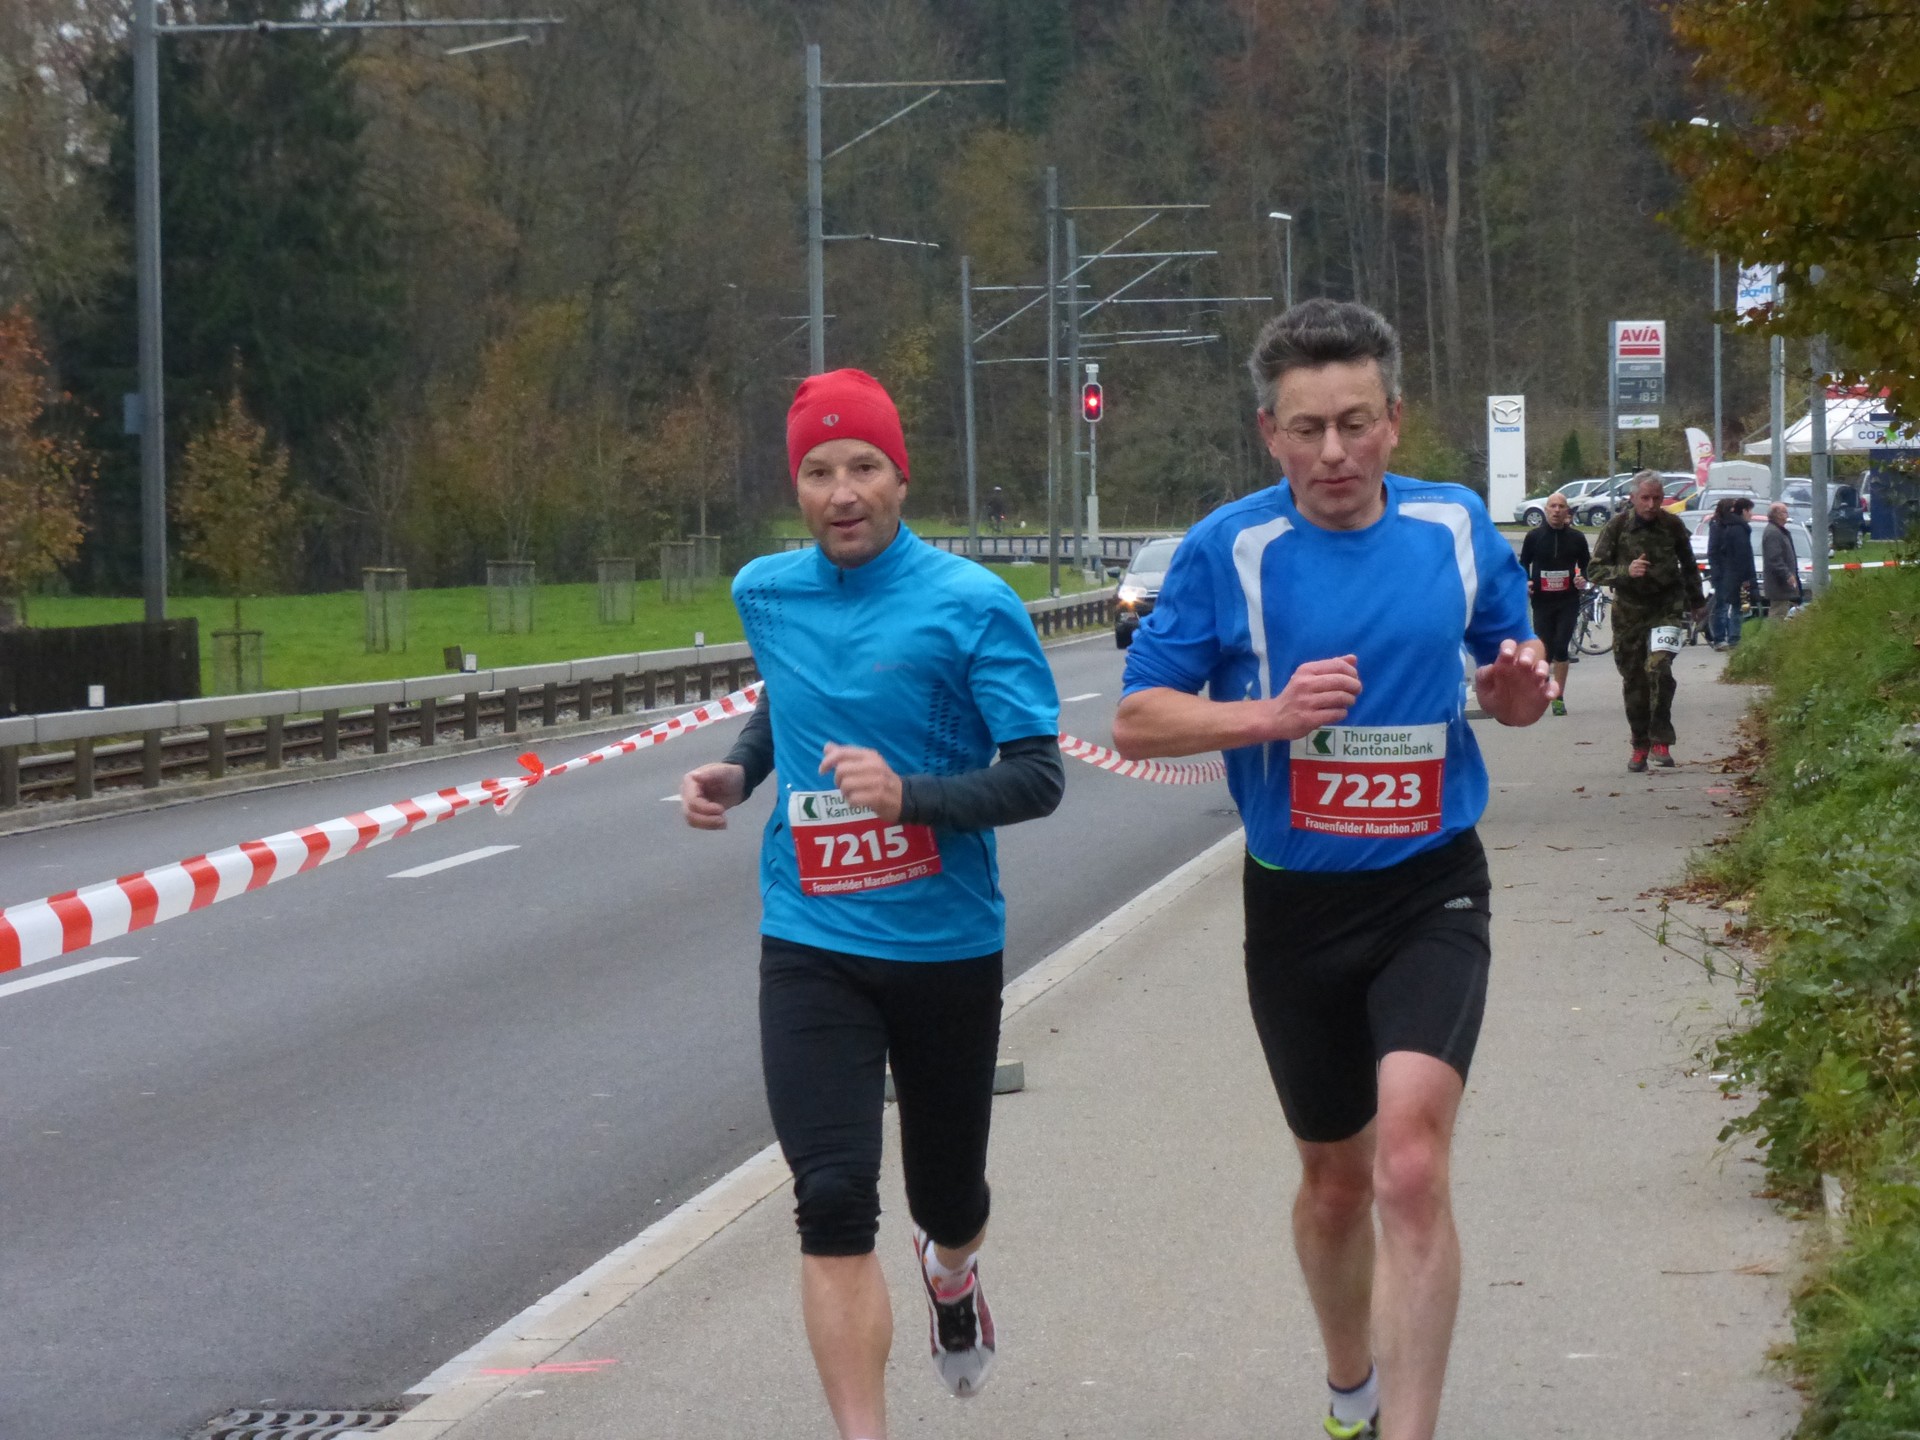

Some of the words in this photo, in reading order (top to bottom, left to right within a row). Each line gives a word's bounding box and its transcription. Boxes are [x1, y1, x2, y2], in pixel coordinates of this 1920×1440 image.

[1343, 730, 1412, 745] Thurgauer
[1343, 742, 1433, 756] Kantonalbank
[1317, 772, 1421, 808] 7223
[1305, 817, 1363, 834] Frauenfelder
[1365, 822, 1409, 834] Marathon
[1411, 821, 1428, 833] 2013
[814, 825, 909, 868] 7215
[812, 879, 863, 893] Frauenfelder
[864, 871, 907, 888] Marathon
[908, 864, 928, 879] 2013
